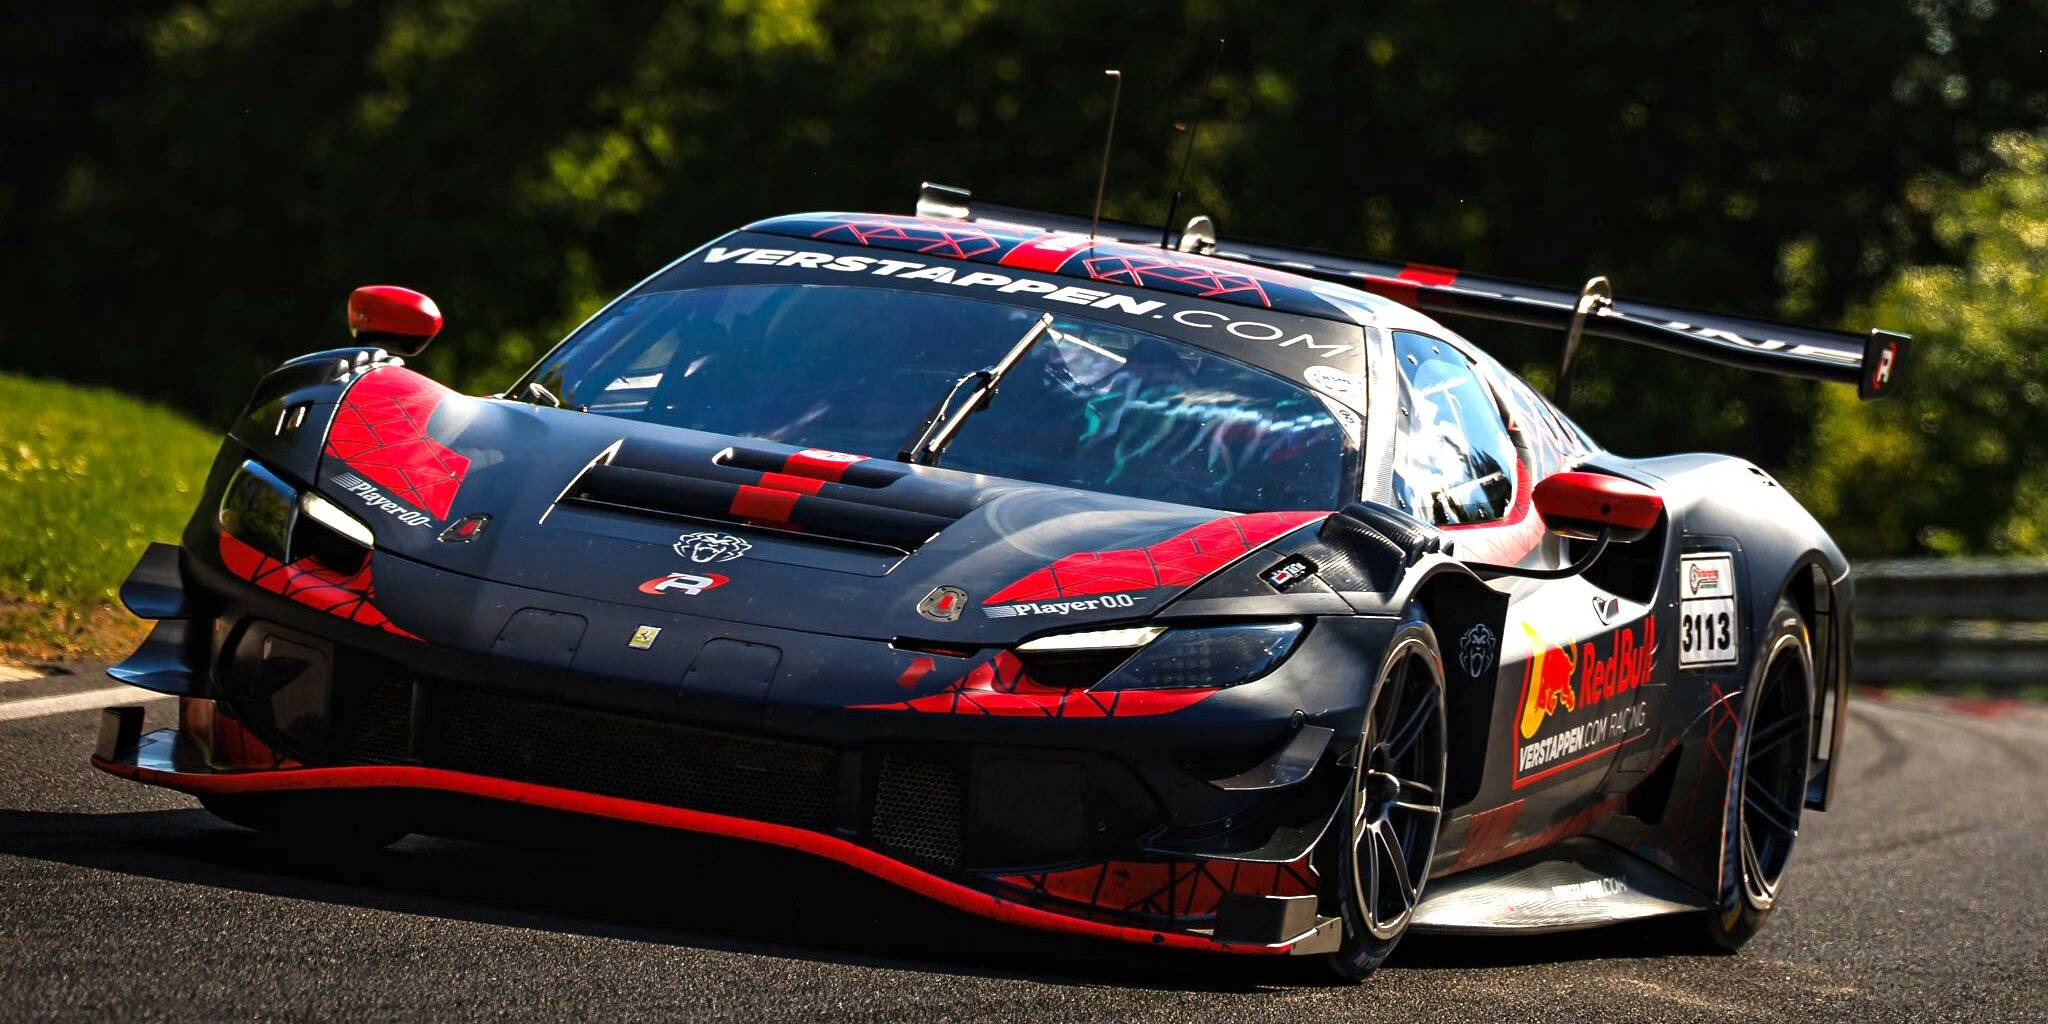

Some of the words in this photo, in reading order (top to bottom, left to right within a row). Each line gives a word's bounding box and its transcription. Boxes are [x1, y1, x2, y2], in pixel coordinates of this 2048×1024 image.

[703, 246, 1354, 359] VERSTAPPEN.COM
[346, 481, 408, 516] Player
[1013, 599, 1101, 616] Player
[1682, 611, 1731, 653] 3113
[1578, 628, 1620, 709] Red
[1519, 716, 1608, 772] VERSTAPPEN.COM
[1609, 701, 1648, 738] RACNG
